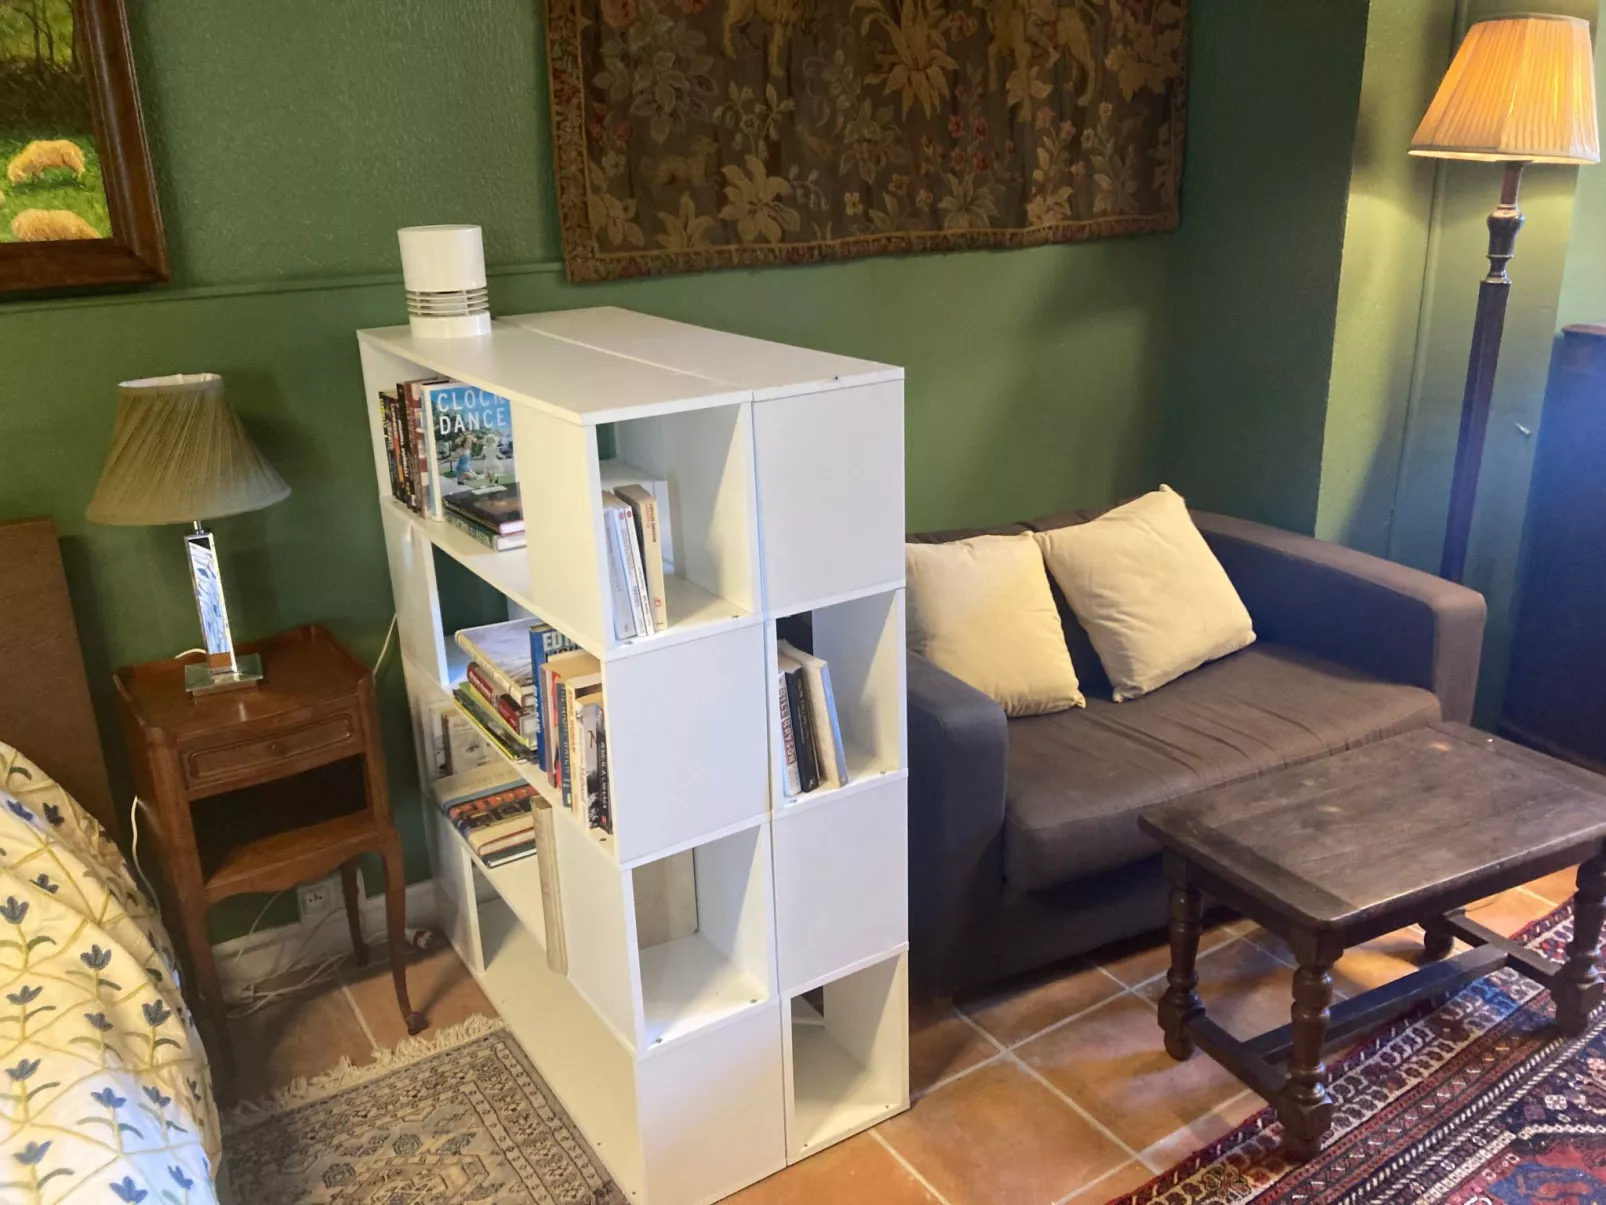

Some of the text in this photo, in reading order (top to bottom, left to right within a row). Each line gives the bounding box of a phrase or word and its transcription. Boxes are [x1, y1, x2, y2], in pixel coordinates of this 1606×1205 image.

[439, 408, 507, 435] DANCE
[778, 687, 796, 765] BILL BRYSON
[563, 741, 571, 774] WATCH
